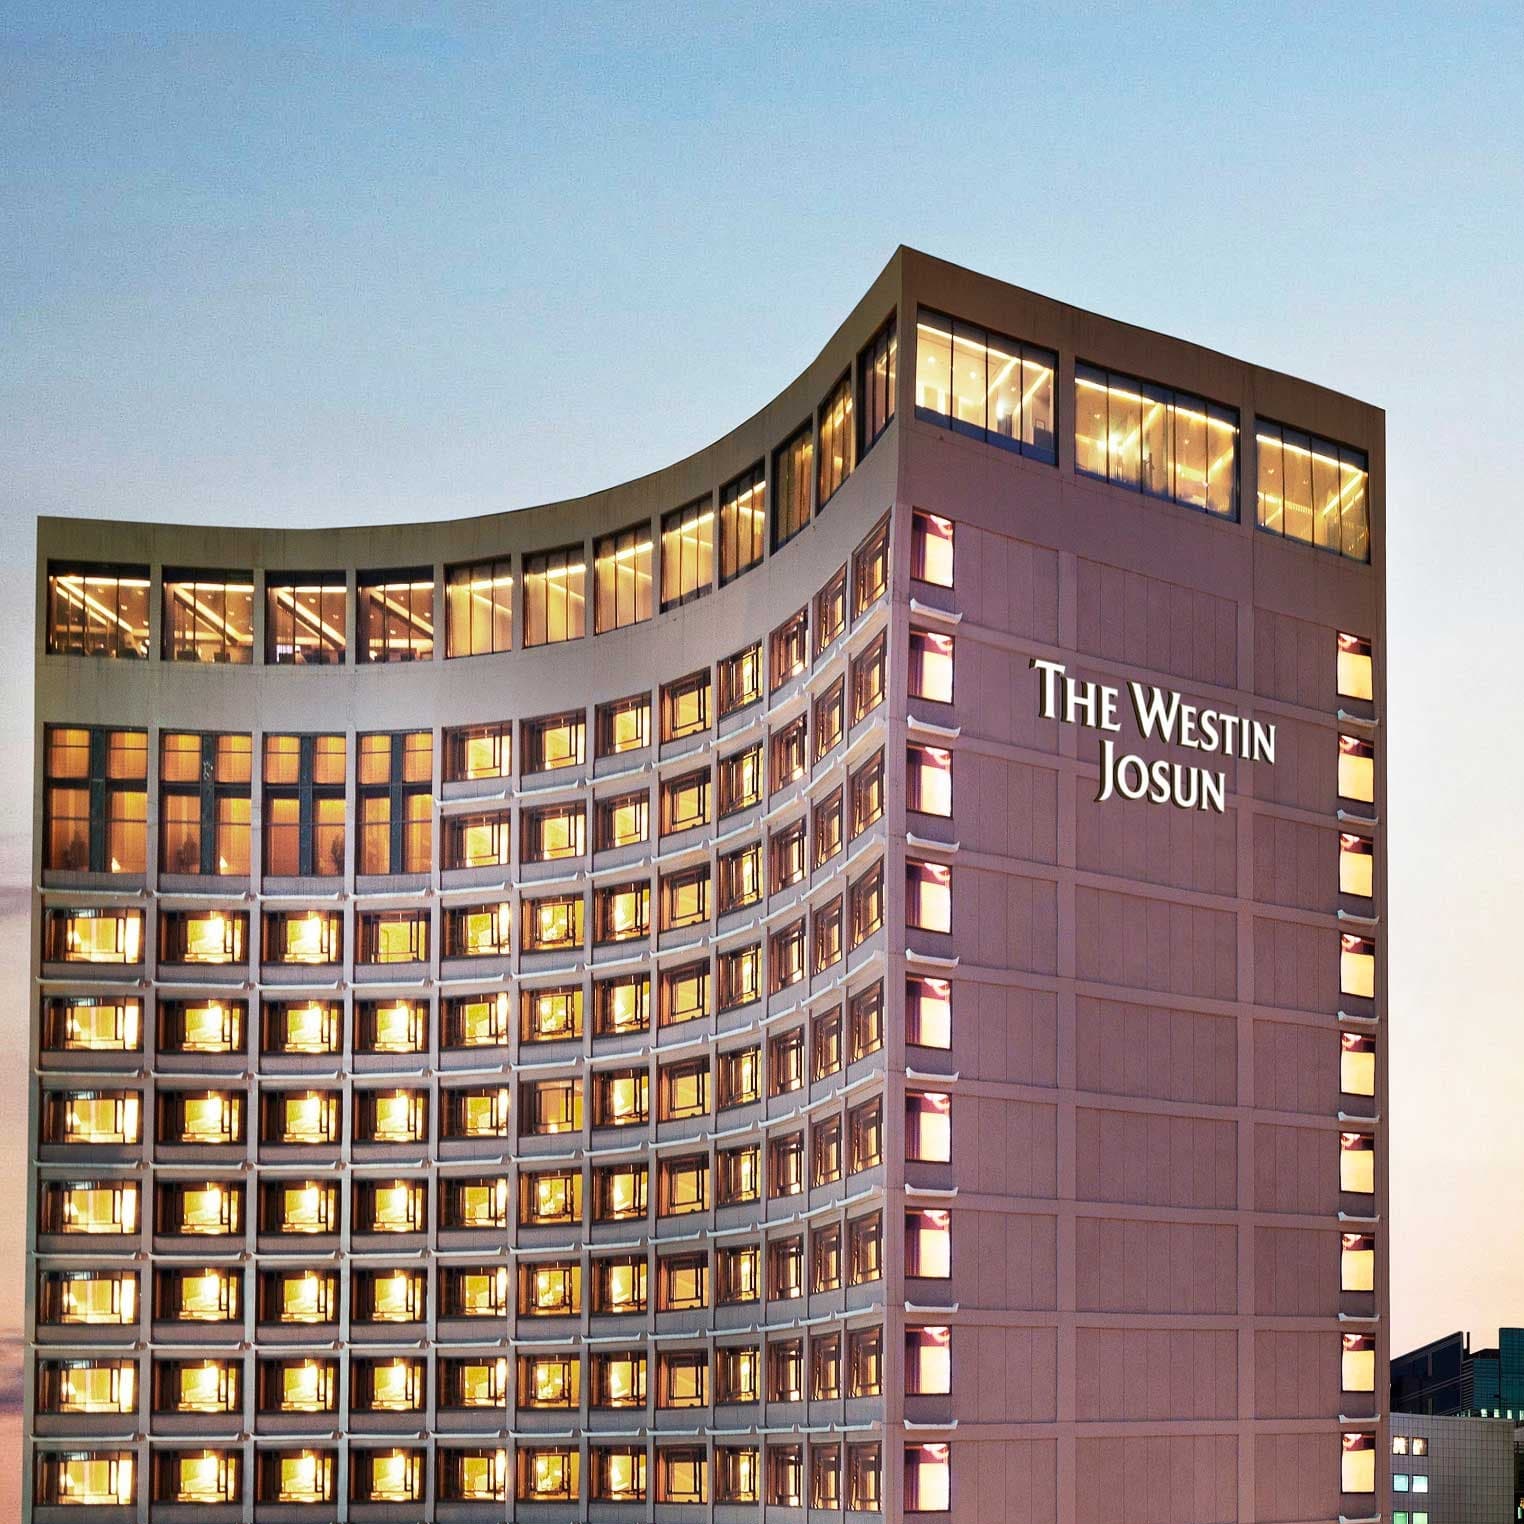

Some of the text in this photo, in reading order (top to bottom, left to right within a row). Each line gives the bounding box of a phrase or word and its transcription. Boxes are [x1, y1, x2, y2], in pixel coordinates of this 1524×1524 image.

[1031, 658, 1277, 765] THE WESTIN
[1095, 738, 1226, 814] JOSUN
